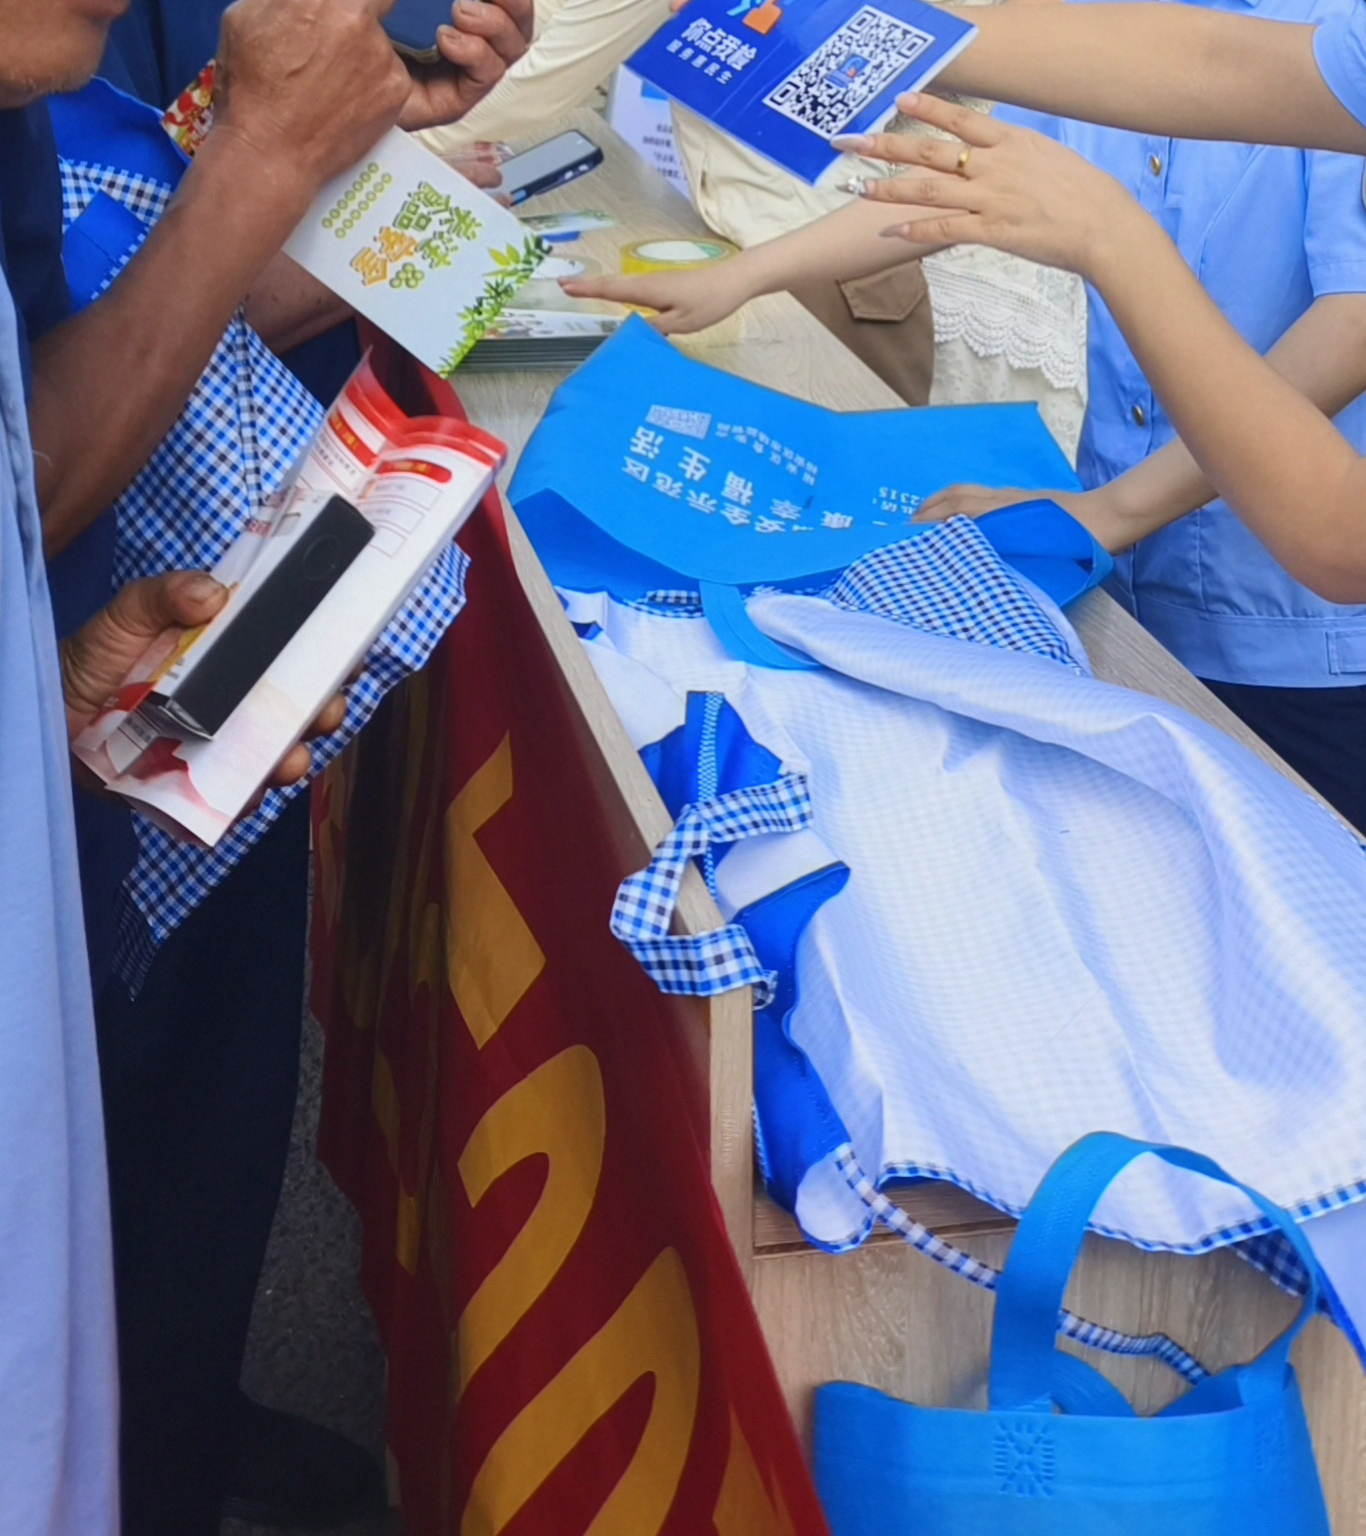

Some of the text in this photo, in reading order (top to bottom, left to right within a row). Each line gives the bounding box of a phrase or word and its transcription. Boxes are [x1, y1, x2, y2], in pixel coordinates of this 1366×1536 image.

[680, 16, 760, 73] 你点我检
[620, 455, 815, 534] 安全示范区
